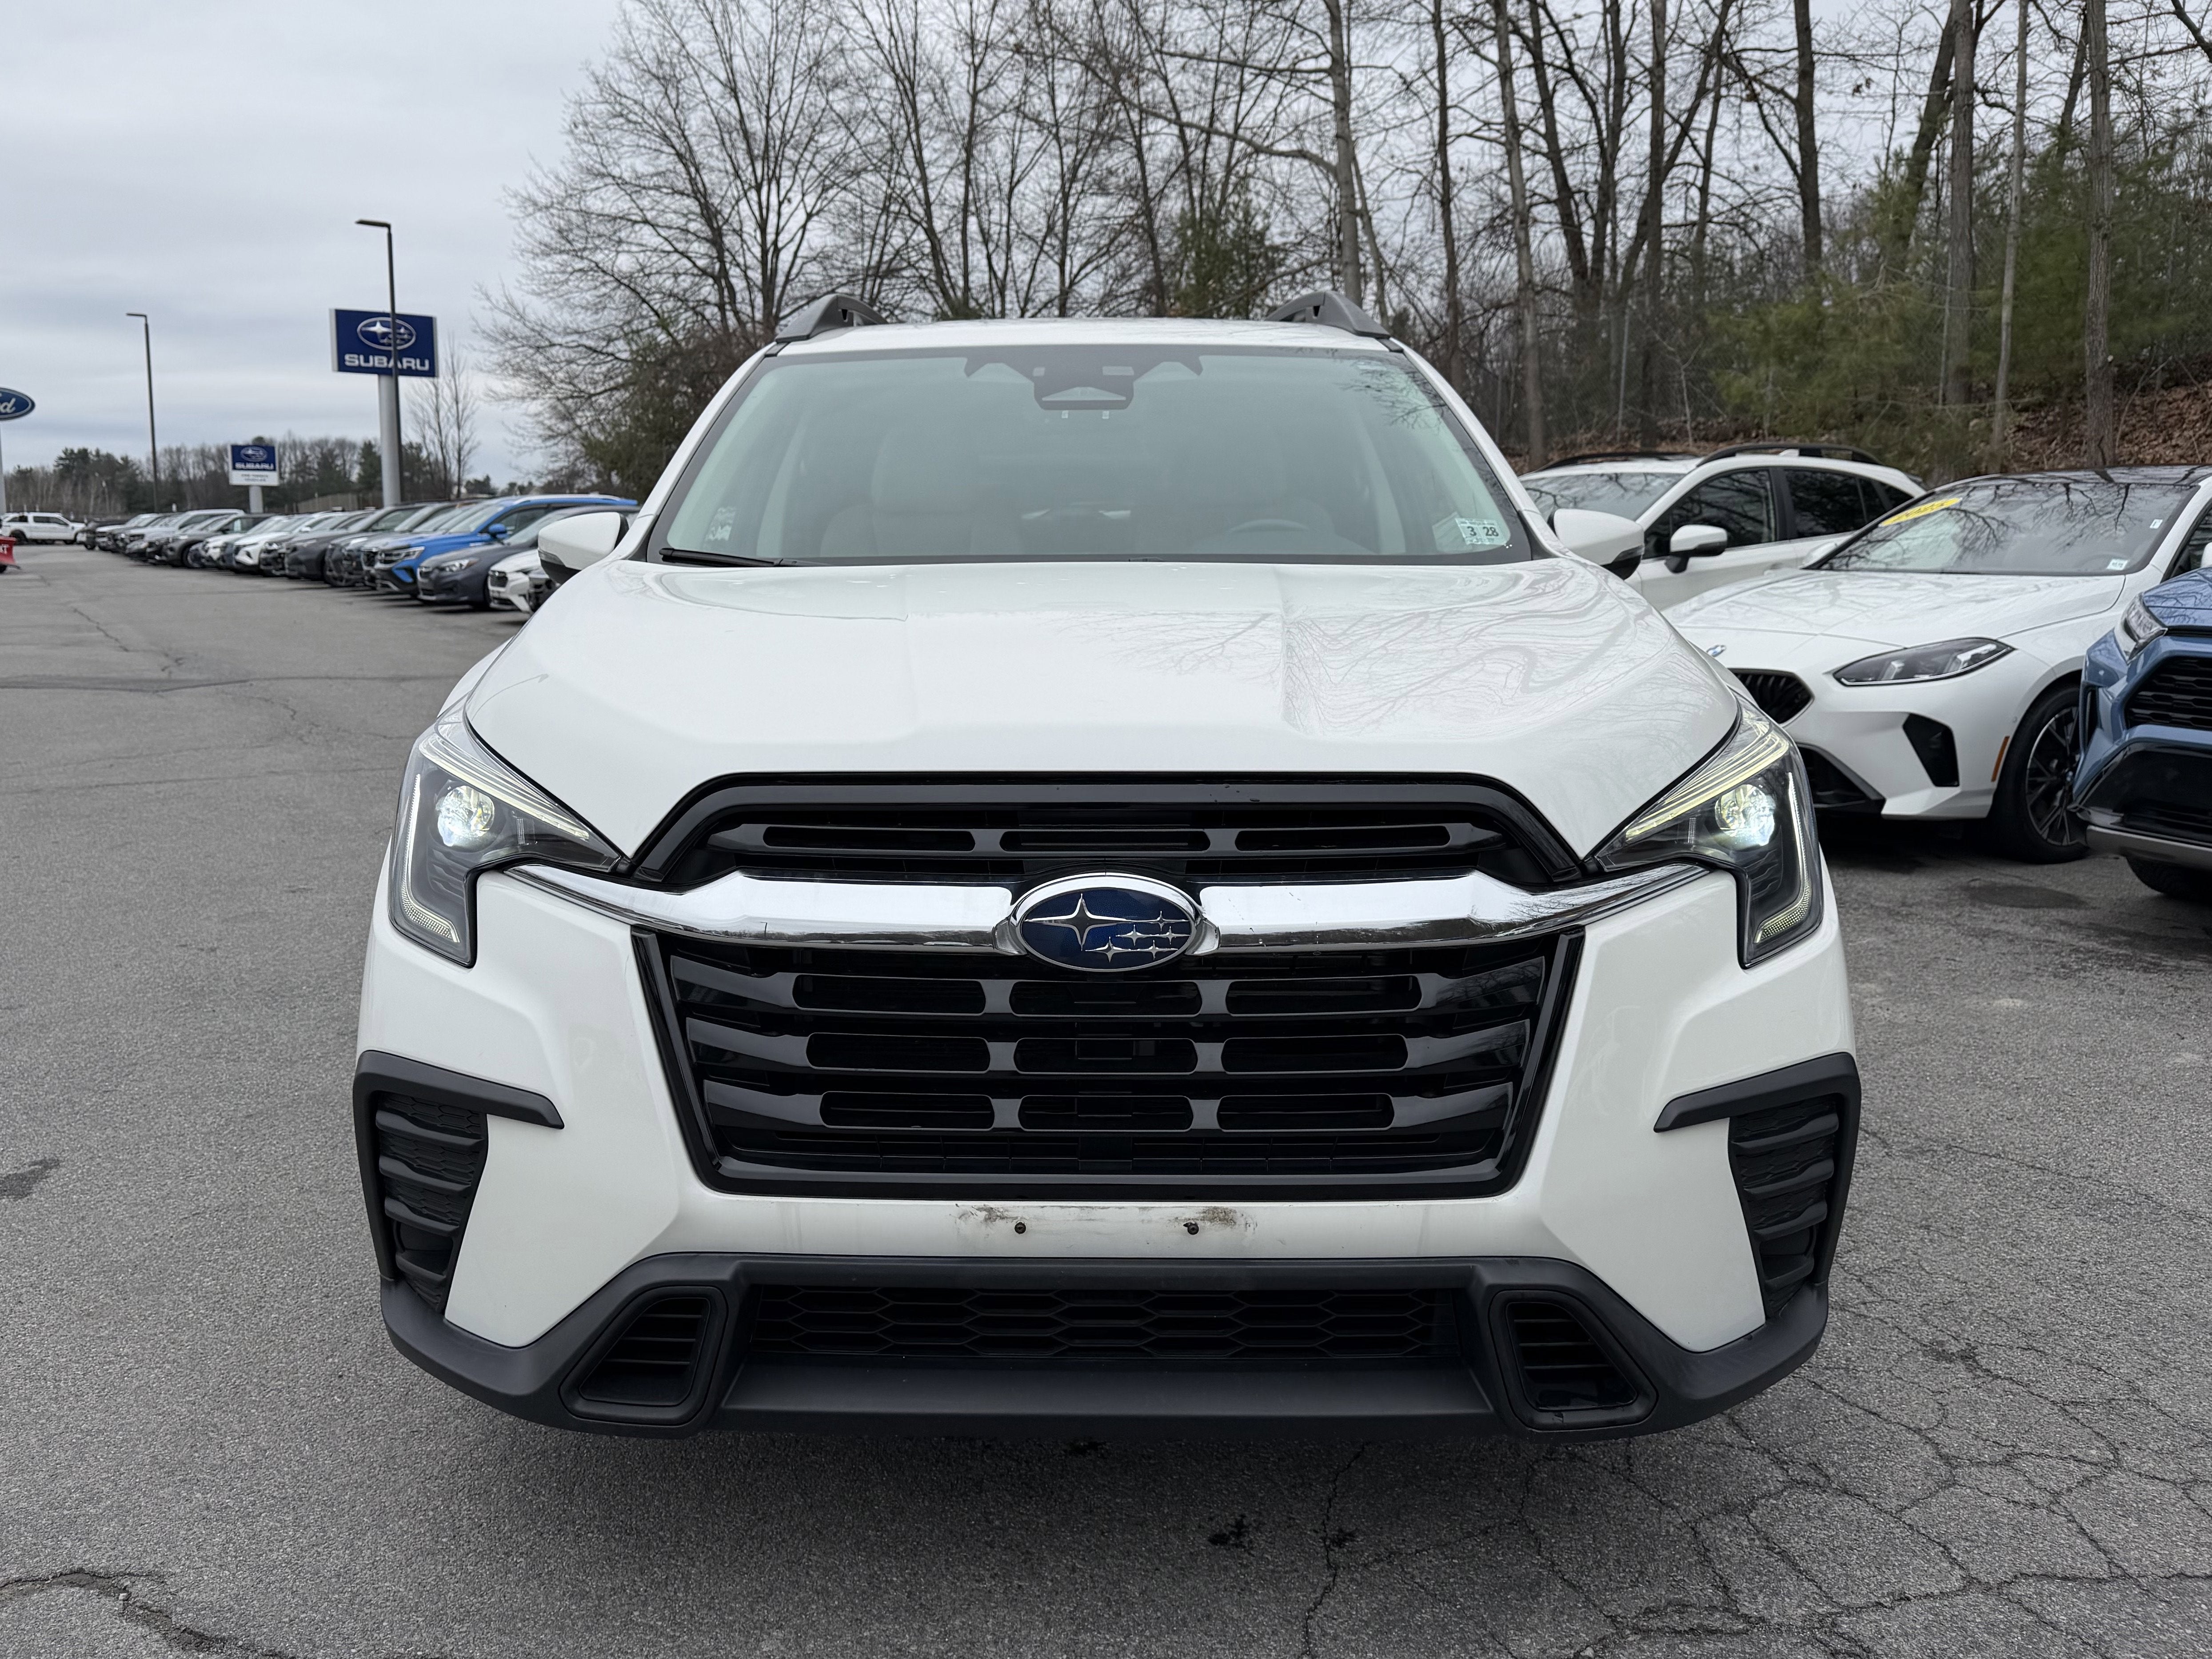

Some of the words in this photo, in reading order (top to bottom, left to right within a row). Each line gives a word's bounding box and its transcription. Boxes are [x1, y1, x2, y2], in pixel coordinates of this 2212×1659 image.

[344, 354, 430, 371] SUBARU
[1467, 526, 1477, 536] 3
[1483, 527, 1499, 536] 28
